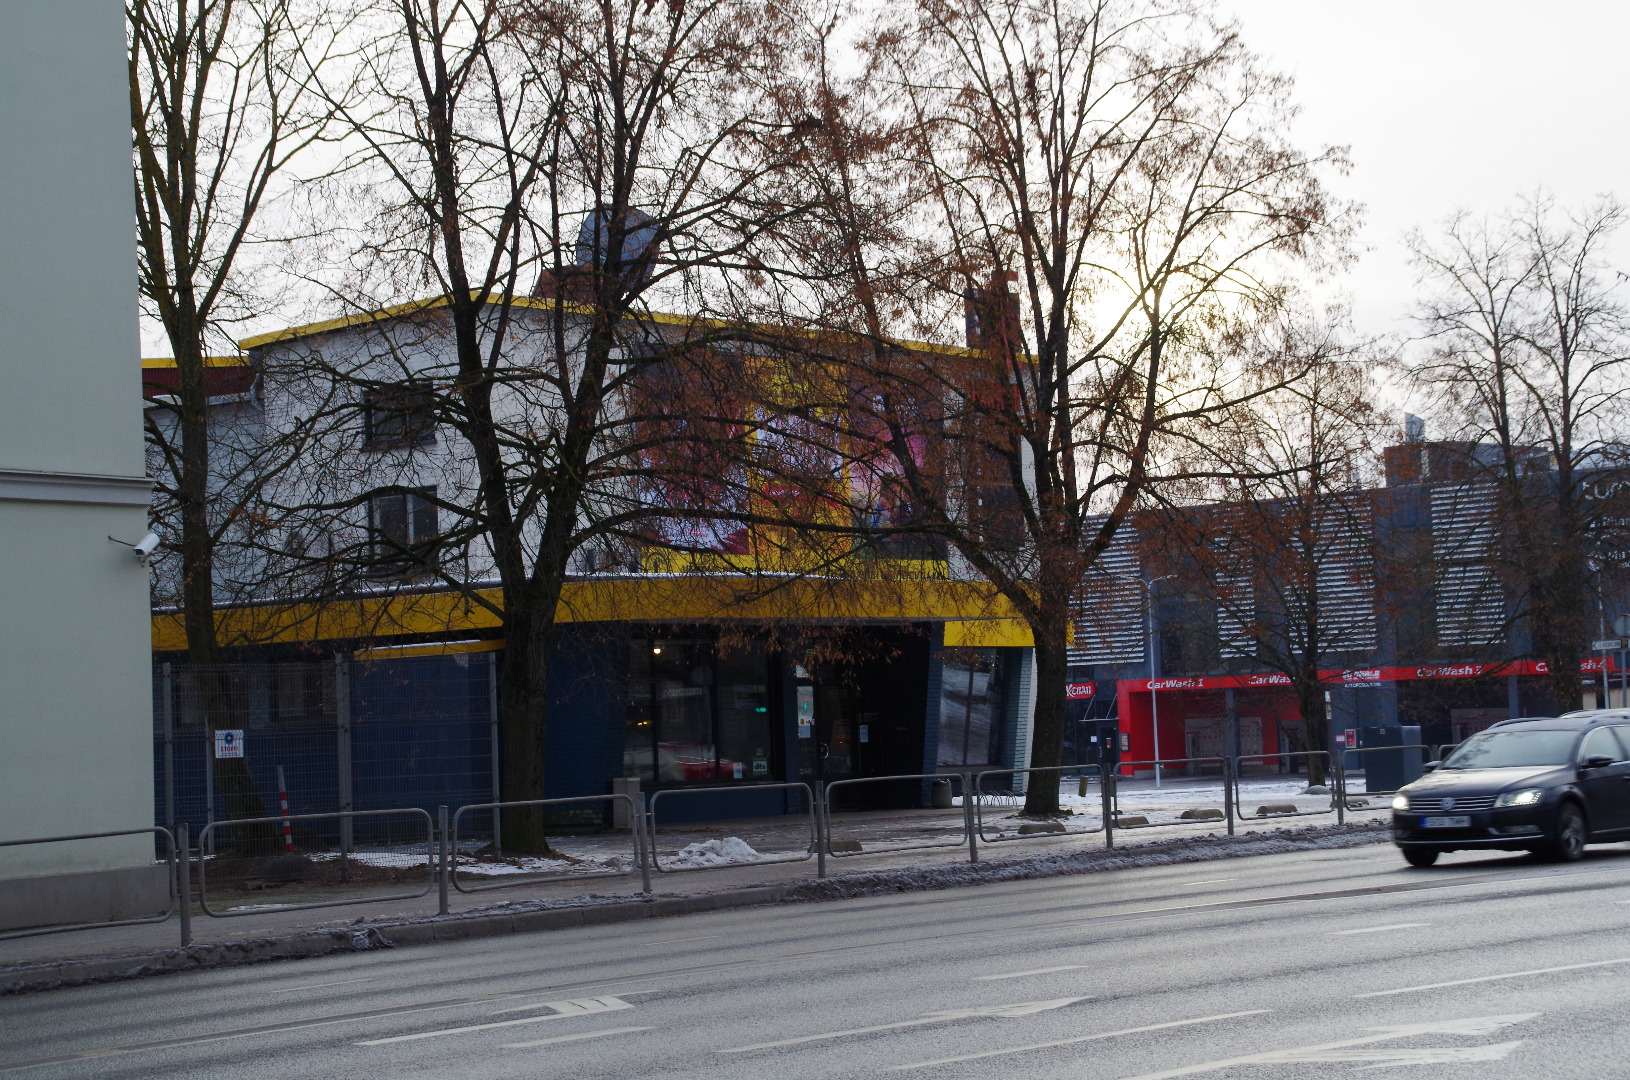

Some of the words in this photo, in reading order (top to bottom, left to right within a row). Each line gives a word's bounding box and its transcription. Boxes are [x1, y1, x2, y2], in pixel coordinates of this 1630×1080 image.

[1416, 665, 1473, 677] CarWash
[1146, 678, 1196, 690] CarWash
[1248, 674, 1296, 685] CarWas
